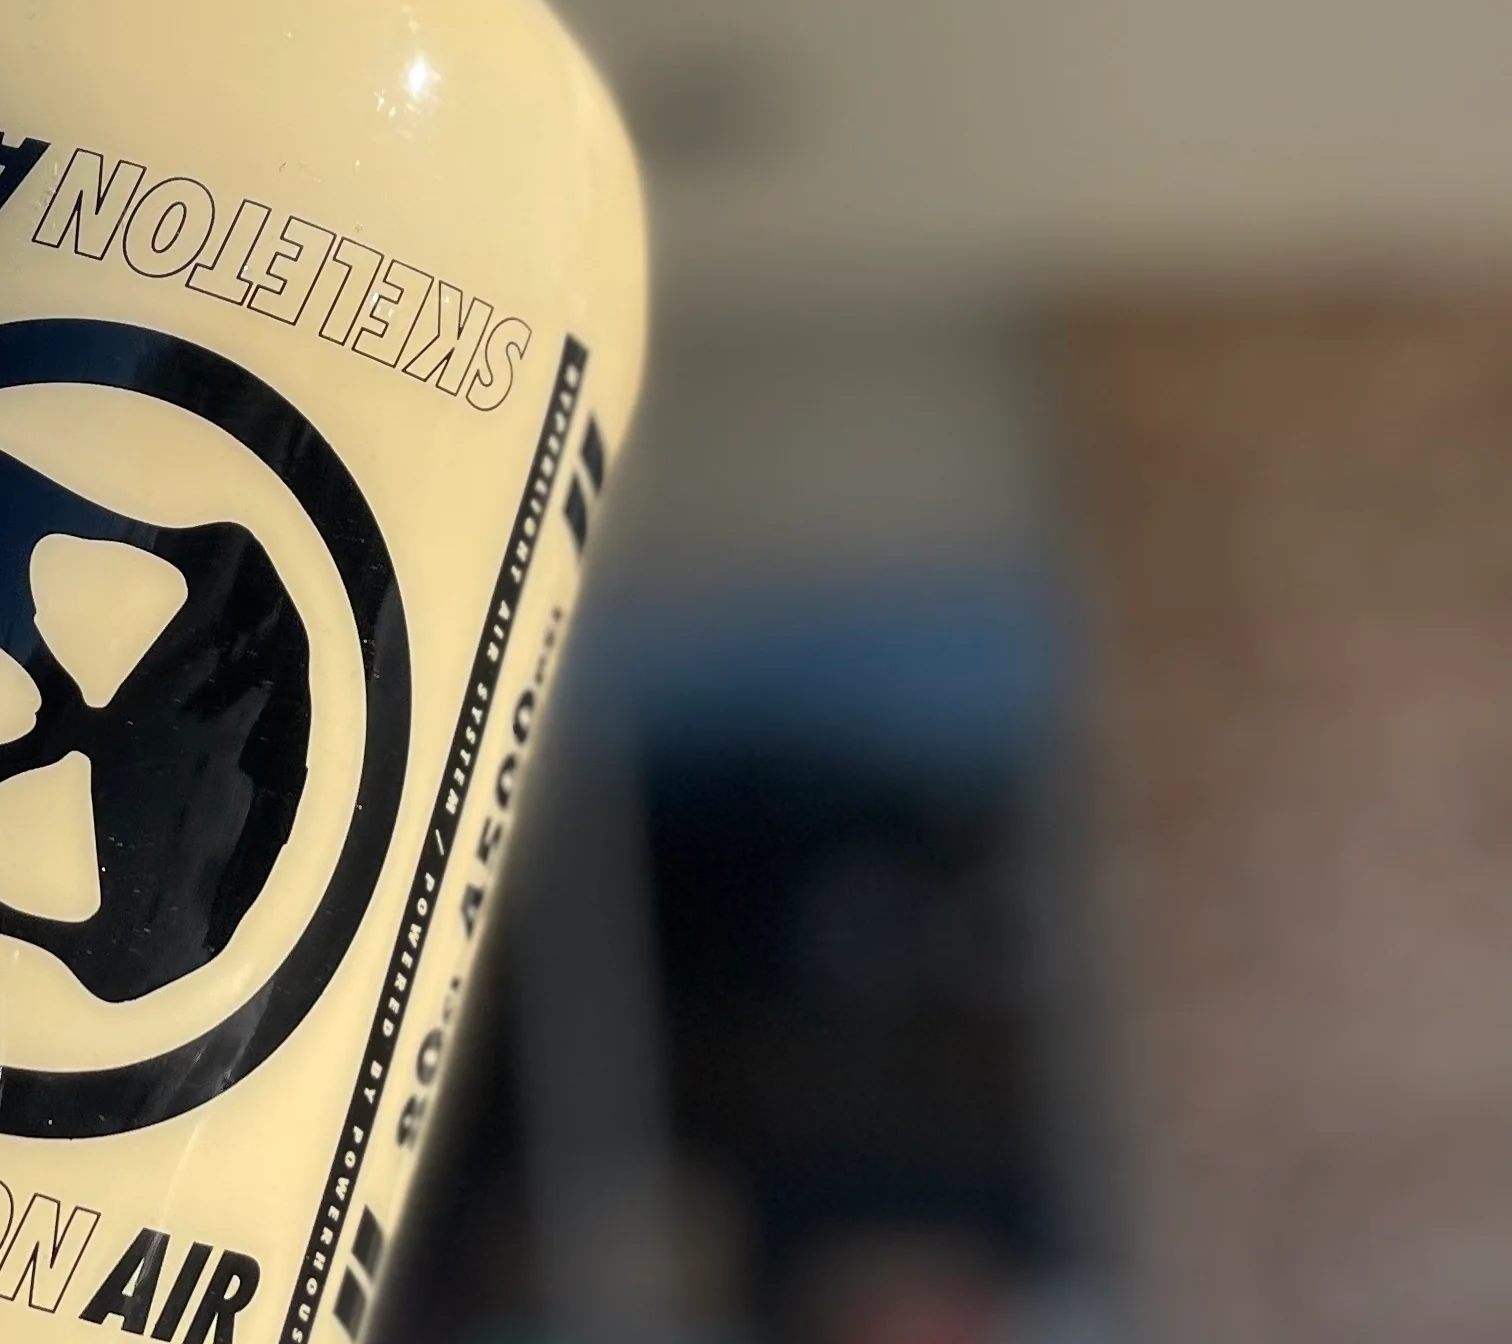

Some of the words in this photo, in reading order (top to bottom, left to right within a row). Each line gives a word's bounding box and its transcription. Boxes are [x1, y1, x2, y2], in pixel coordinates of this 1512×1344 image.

[31, 148, 532, 411] SKELETON
[508, 361, 579, 583] HYPERLIGHT
[485, 599, 511, 664] AIR
[443, 682, 489, 816] SYSTEM
[380, 871, 435, 1039] POWERED
[362, 1059, 382, 1105] BY
